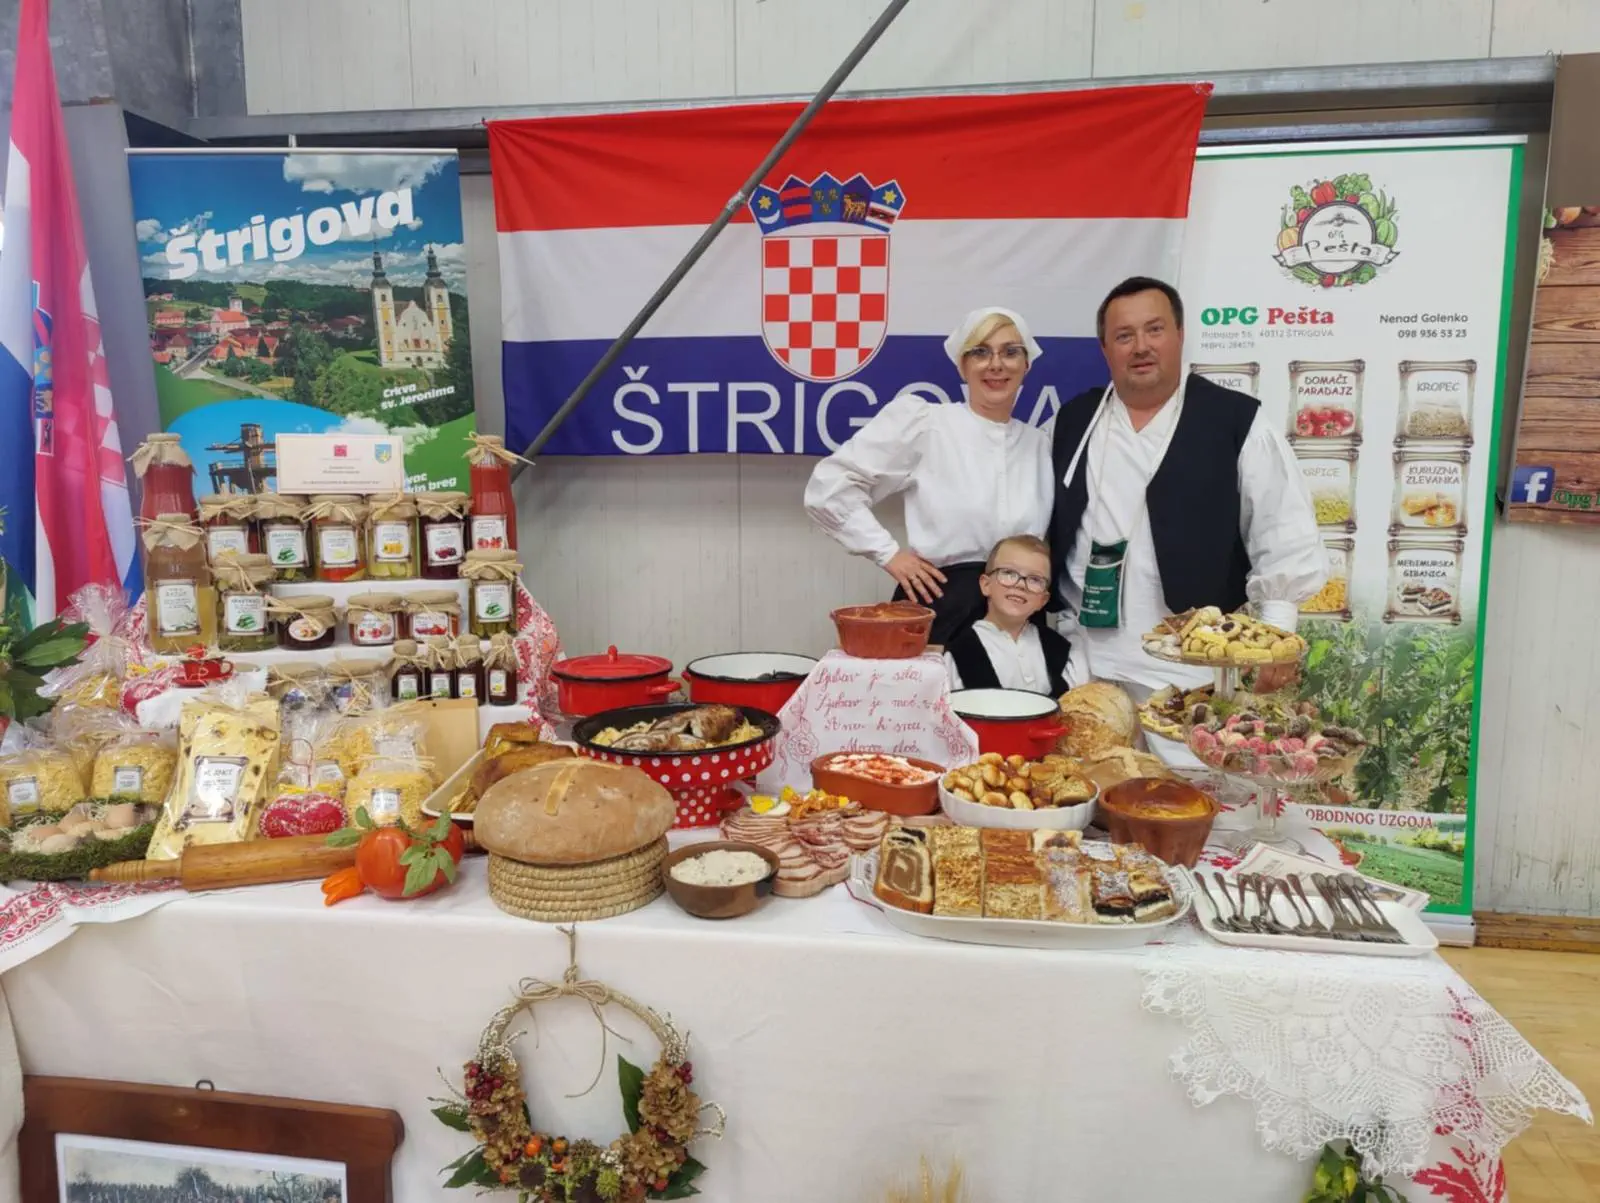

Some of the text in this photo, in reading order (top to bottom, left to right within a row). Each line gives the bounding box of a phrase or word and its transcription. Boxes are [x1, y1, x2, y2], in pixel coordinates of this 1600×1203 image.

[165, 187, 414, 280] Štrigova
[1200, 305, 1335, 326] OPG Pešta
[1379, 312, 1469, 323] Nenad Golenko
[1397, 329, 1418, 338] 098
[383, 383, 417, 398] Crkva
[1298, 386, 1353, 396] PARADAJZ
[1416, 381, 1461, 392] KROPEC
[399, 385, 455, 406] Jeronima
[1306, 808, 1434, 829] OBODNOG UZGOJA
